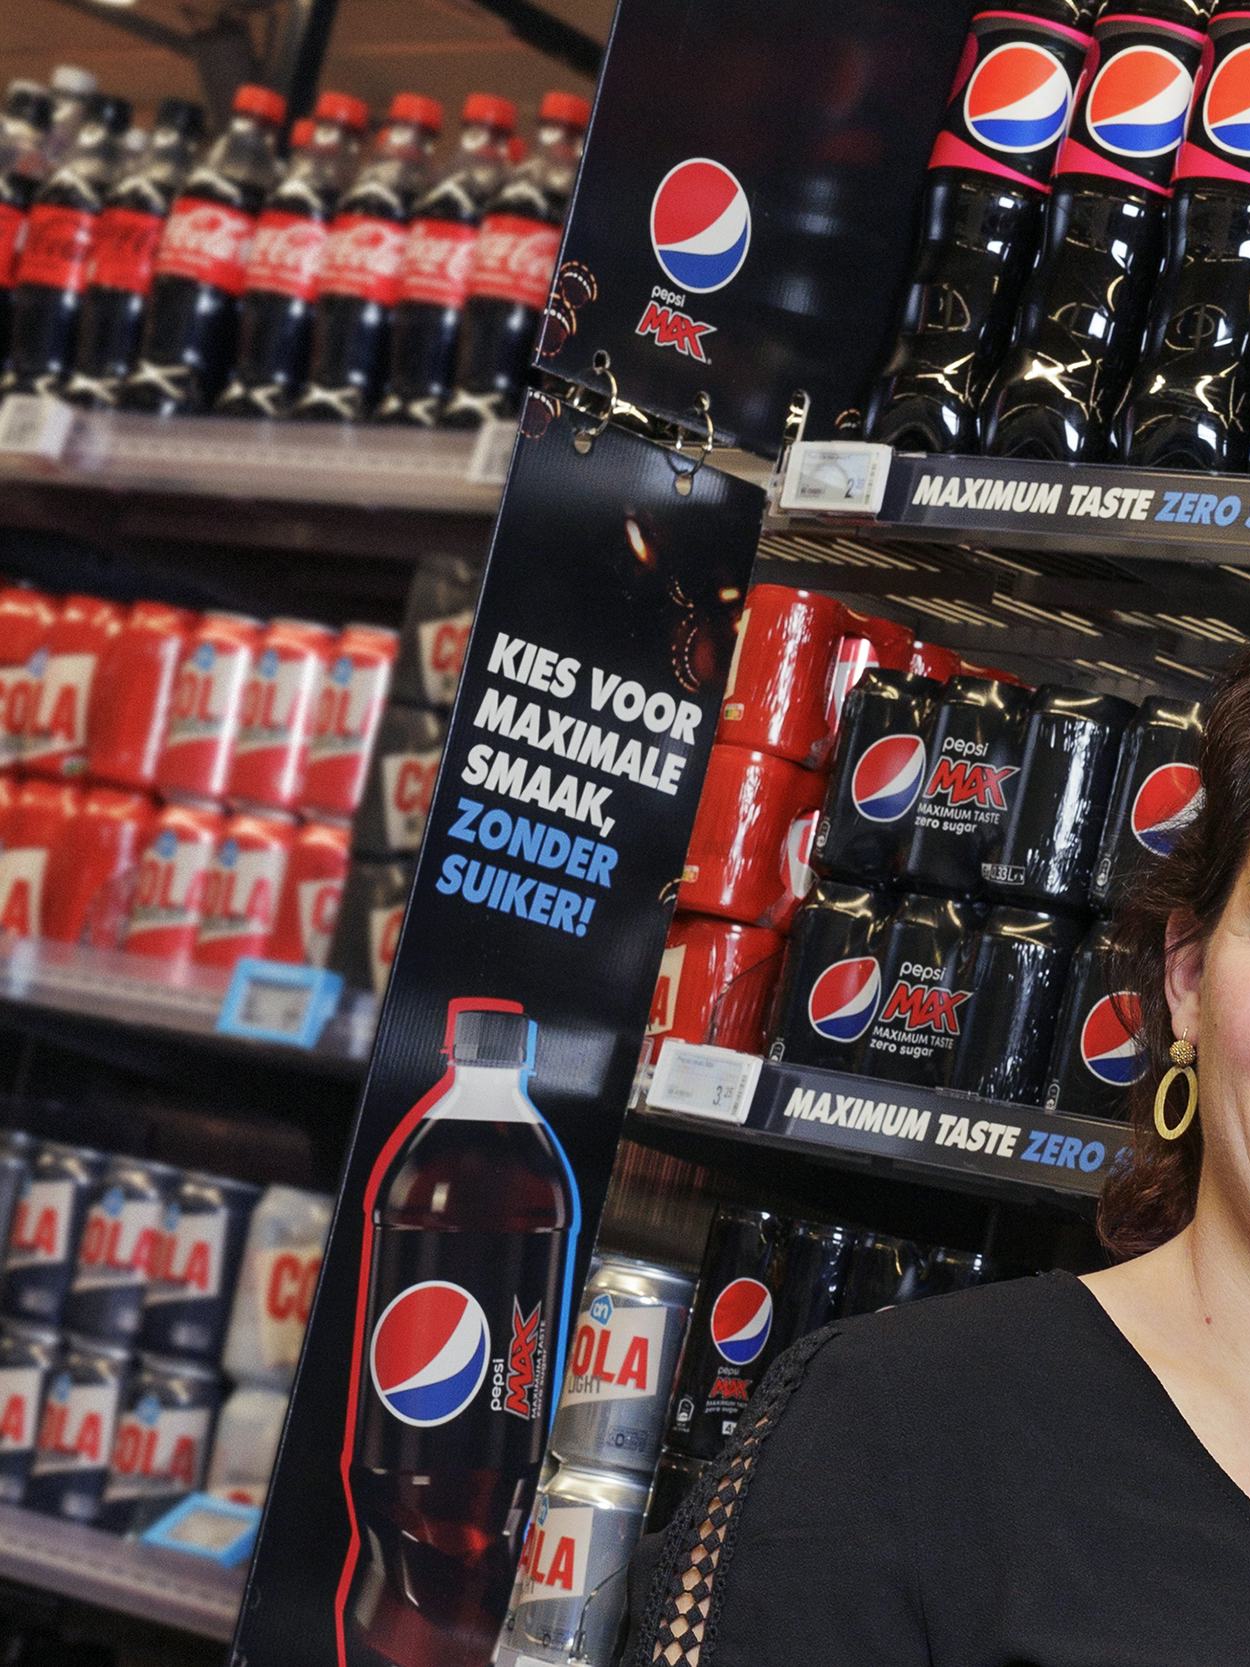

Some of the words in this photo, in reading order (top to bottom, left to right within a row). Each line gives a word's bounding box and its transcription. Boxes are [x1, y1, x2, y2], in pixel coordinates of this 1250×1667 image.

[651, 285, 686, 308] pepsi
[635, 300, 717, 364] MAX
[912, 475, 1062, 514] MAXIMUM
[1066, 485, 1155, 521] TASTE
[1154, 491, 1241, 527] ZERO
[487, 632, 581, 698] KIES
[590, 667, 702, 745] VOOR
[473, 688, 687, 796] MAXIMALE
[942, 737, 989, 757] pepsi
[461, 744, 615, 838] SMAAK,
[922, 755, 1021, 811] MAX
[914, 817, 940, 830] zero
[942, 820, 977, 835] sugar
[917, 803, 972, 821] MAXIMUM
[974, 810, 1001, 825] TASTE
[448, 797, 618, 888] ZONDER
[435, 854, 596, 937] SUIKER!
[900, 961, 946, 981] pepsi
[879, 979, 974, 1036] MAX
[870, 1038, 897, 1053] zero
[900, 1045, 934, 1059] sugar
[872, 1026, 928, 1045] MAXIMUM
[930, 1035, 954, 1050] TASTE
[784, 1087, 932, 1142] MAXIMUM
[936, 1113, 1021, 1158] TASTE
[1021, 1130, 1105, 1173] ZERO
[491, 1358, 505, 1411] pepsi
[504, 1294, 542, 1420] MAX
